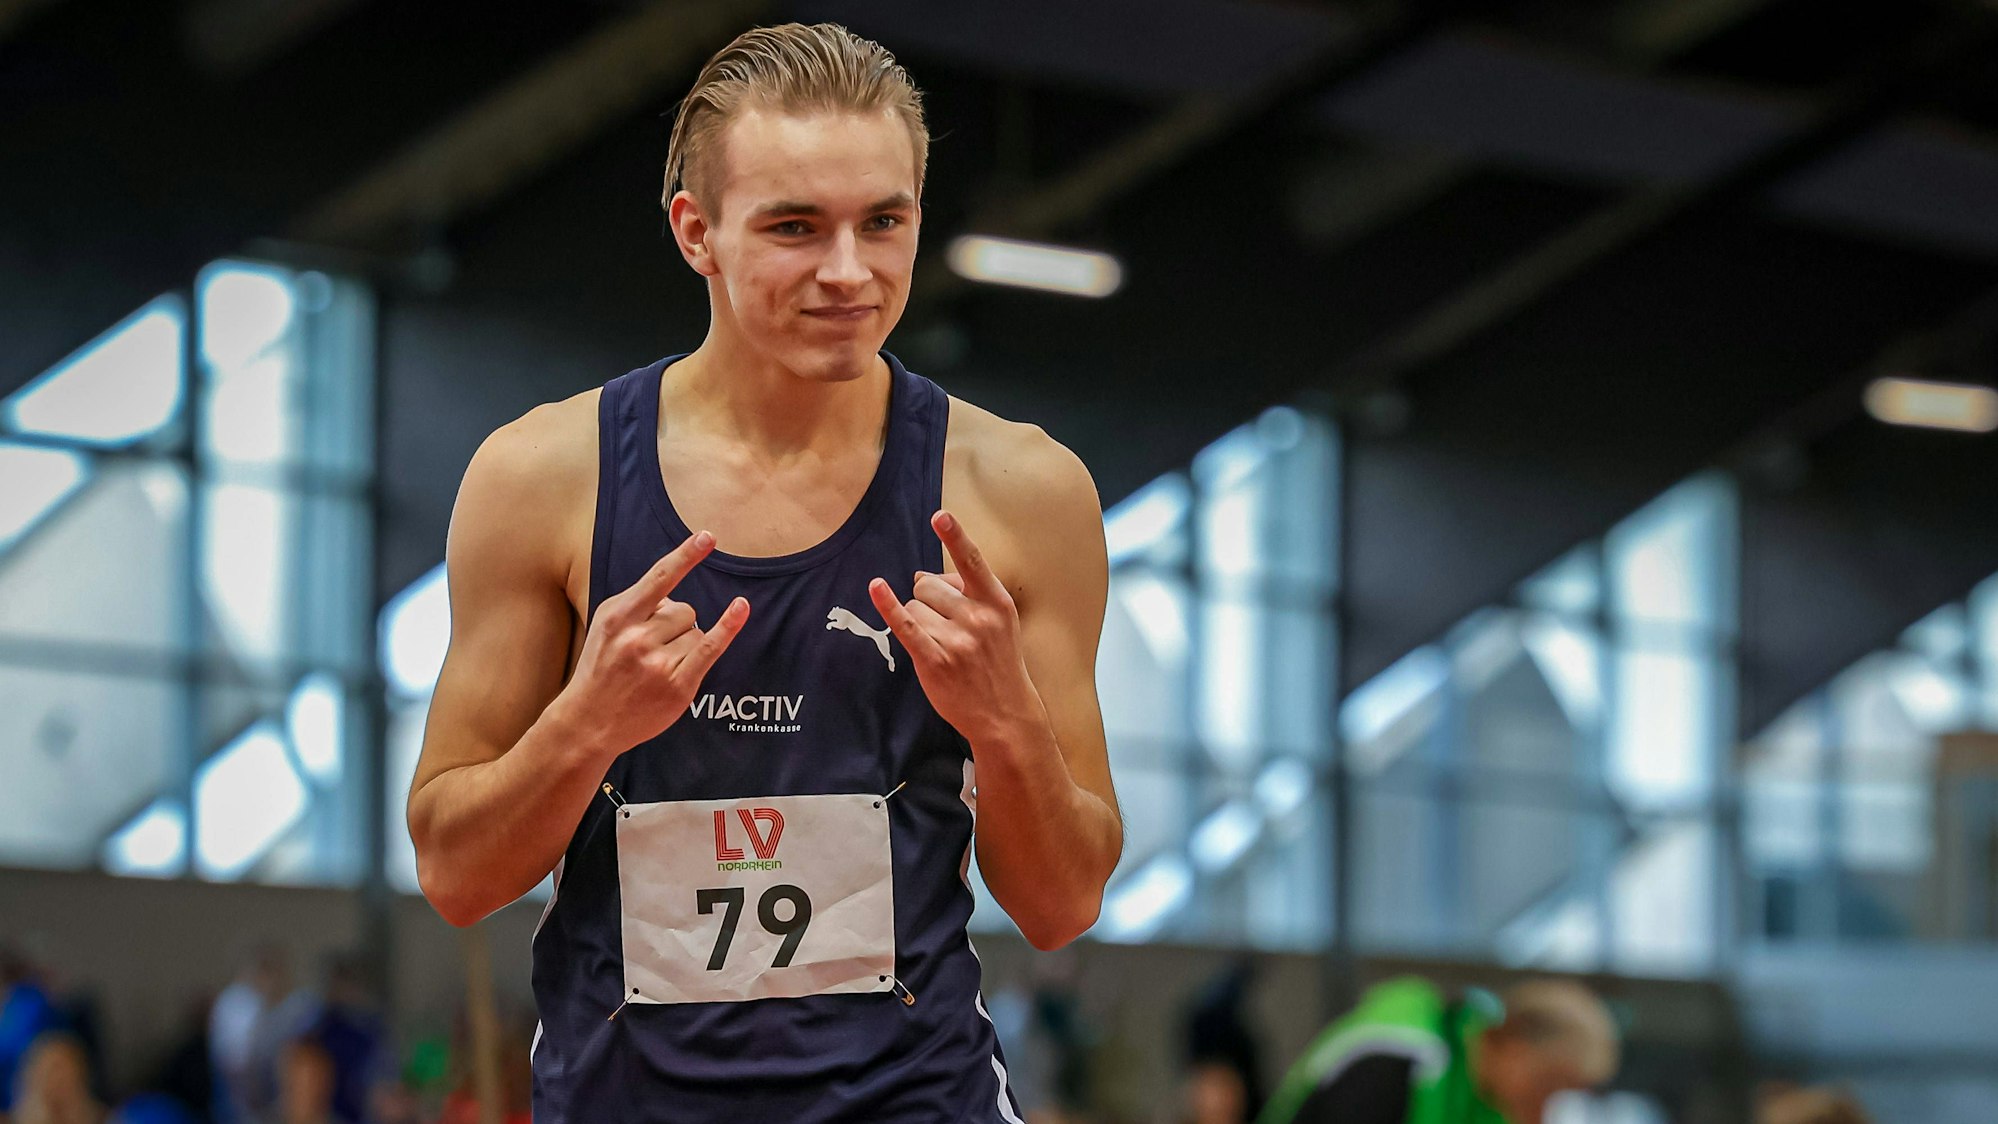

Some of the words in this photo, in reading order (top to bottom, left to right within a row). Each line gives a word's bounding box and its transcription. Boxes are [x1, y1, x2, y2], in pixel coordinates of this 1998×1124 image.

[690, 694, 804, 721] VIACTIV
[728, 722, 801, 733] Krankenkasse
[717, 860, 782, 872] NORDRHEIN
[696, 884, 812, 971] 79
